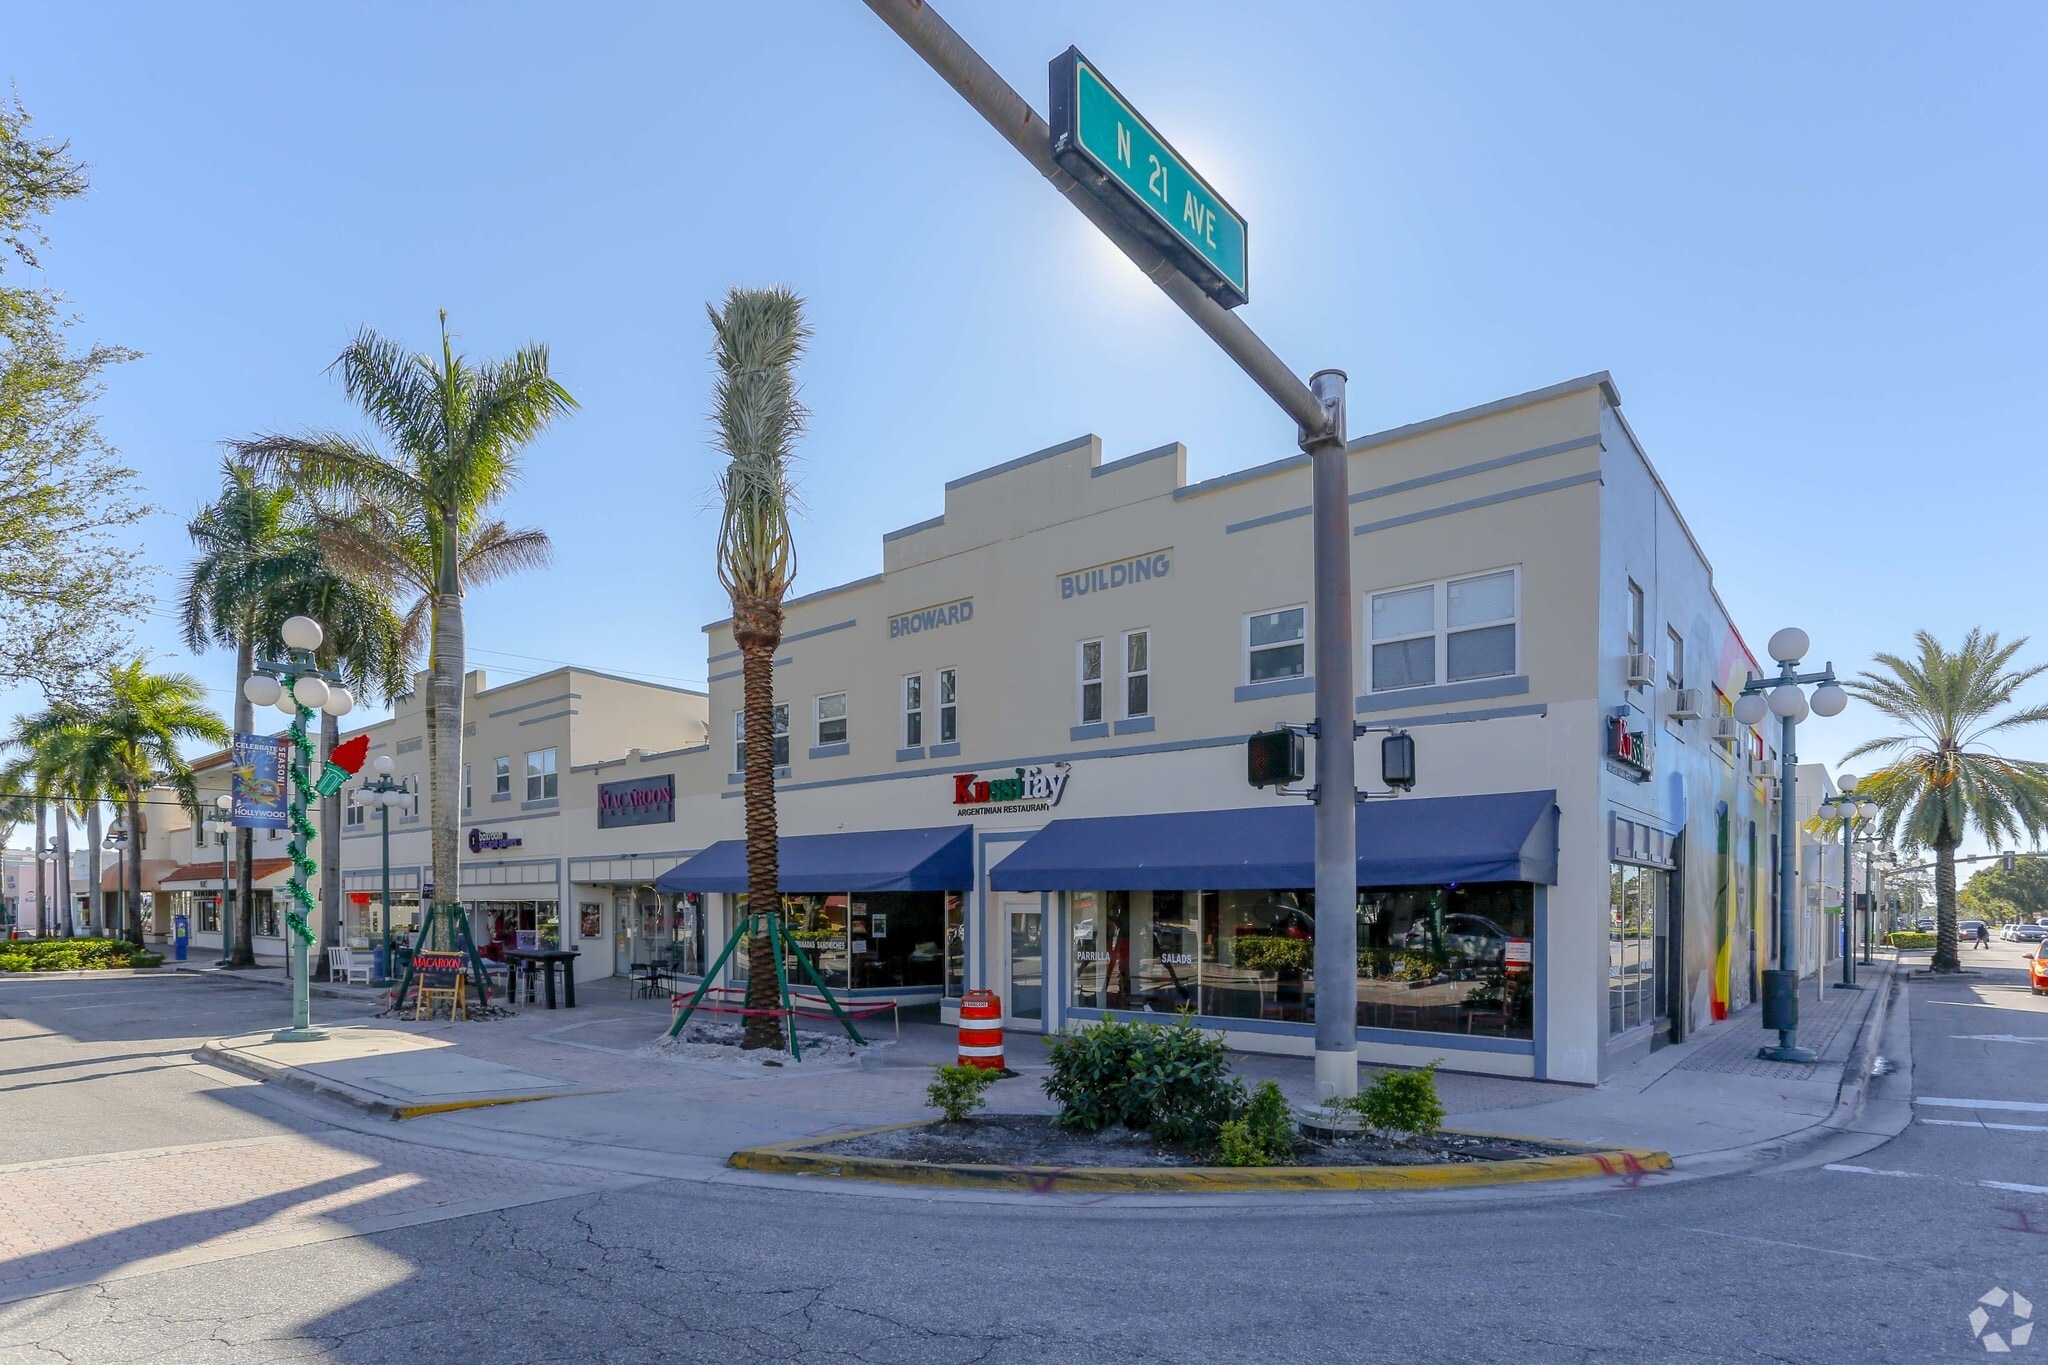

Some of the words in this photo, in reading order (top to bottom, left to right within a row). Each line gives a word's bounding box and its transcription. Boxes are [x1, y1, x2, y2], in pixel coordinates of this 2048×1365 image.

[1117, 121, 1131, 169] N
[1149, 154, 1168, 203] 21
[1183, 190, 1217, 249] AVE
[890, 601, 974, 639] BROWARD
[1061, 554, 1170, 600] BUILDING
[235, 741, 278, 752] CELEBRATE
[277, 746, 286, 786] SEASON!
[953, 767, 1068, 807] Kussifay
[599, 787, 670, 809] MACAROON
[234, 808, 286, 818] HOLLYWOOD
[957, 806, 1002, 817] ARGENTINIAN
[1003, 803, 1050, 814] RESTAURANT
[817, 941, 845, 950] SANDWICHES
[413, 956, 460, 968] MACAROON
[1077, 951, 1110, 961] PARRILLA
[1161, 953, 1192, 964] SALADS
